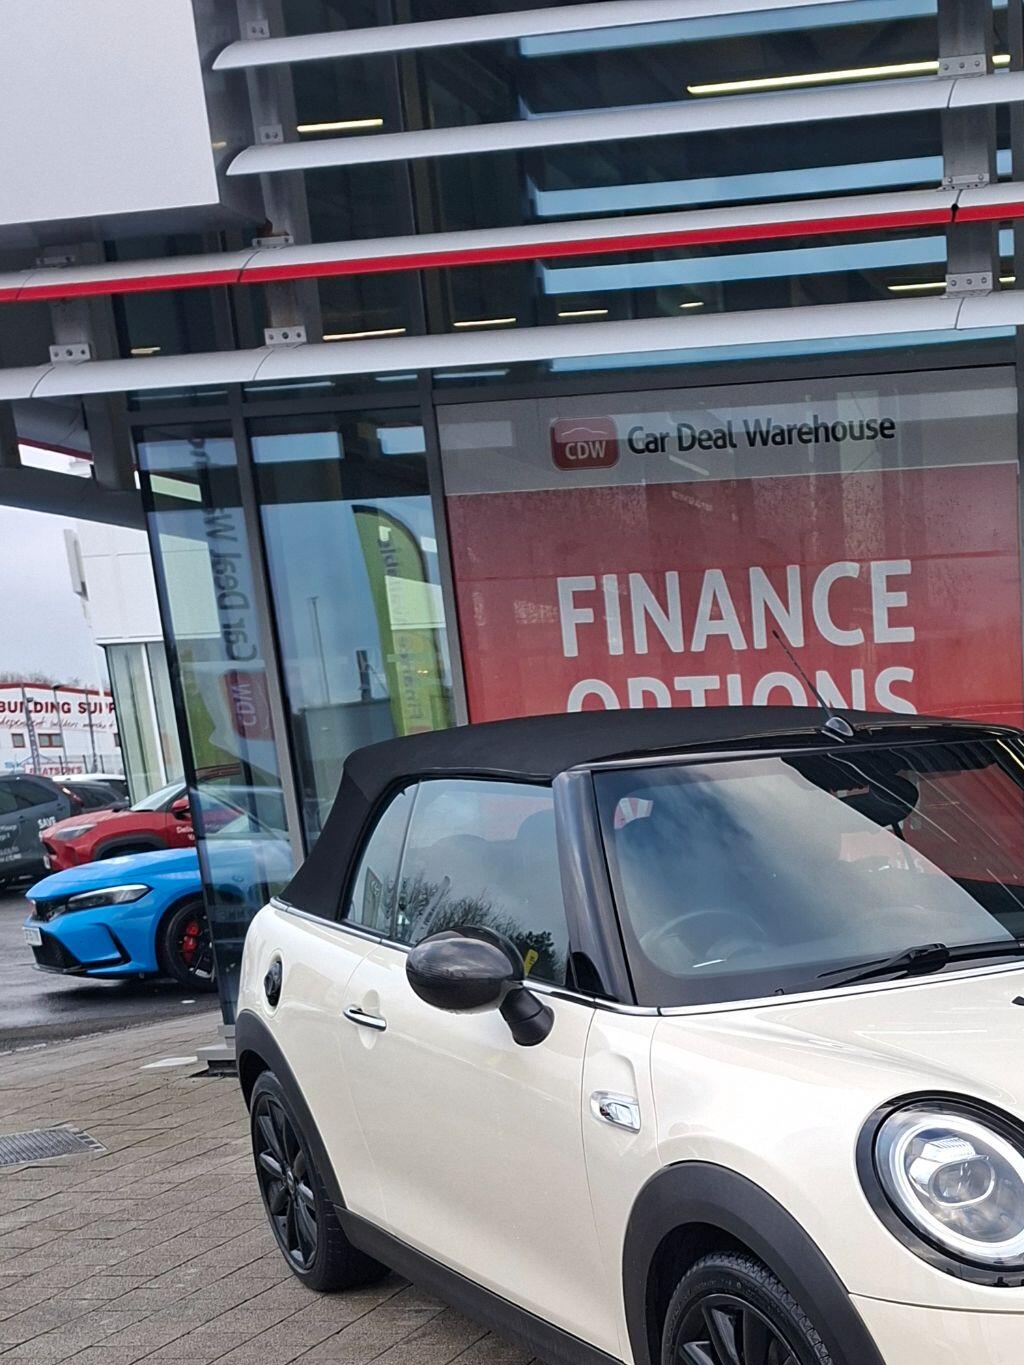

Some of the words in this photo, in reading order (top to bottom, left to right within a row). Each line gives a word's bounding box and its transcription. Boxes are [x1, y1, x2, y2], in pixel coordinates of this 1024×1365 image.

[565, 439, 607, 461] CDW
[627, 426, 670, 454] Car
[678, 420, 737, 452] Deal
[743, 414, 897, 448] Warehouse
[556, 558, 916, 658] FINANCE
